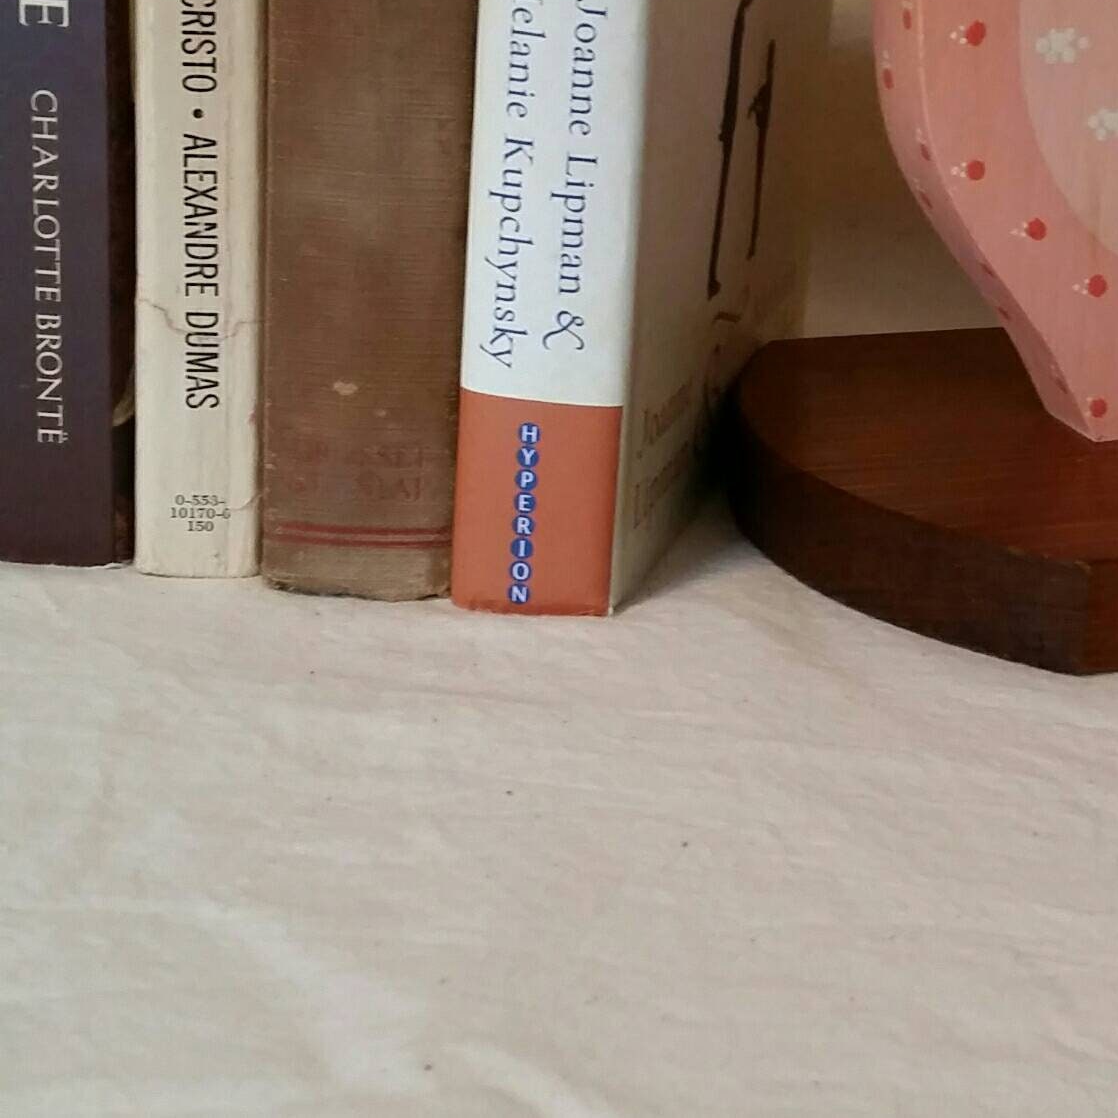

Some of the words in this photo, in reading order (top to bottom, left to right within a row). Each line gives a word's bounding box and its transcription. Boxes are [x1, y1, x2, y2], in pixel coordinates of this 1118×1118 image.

[30, 88, 61, 303] CHARLOTTE
[183, 132, 219, 298] ALEXANDRE
[480, 132, 534, 370] Kupchynsky
[550, 151, 598, 295] Lipman
[36, 313, 68, 444] BRONTË
[185, 311, 220, 410] DUMAS
[542, 310, 586, 352] &
[171, 507, 231, 519] 10170-6
[175, 494, 226, 507] 0-553-
[187, 520, 214, 532] 150
[509, 423, 540, 604] HYPERION
